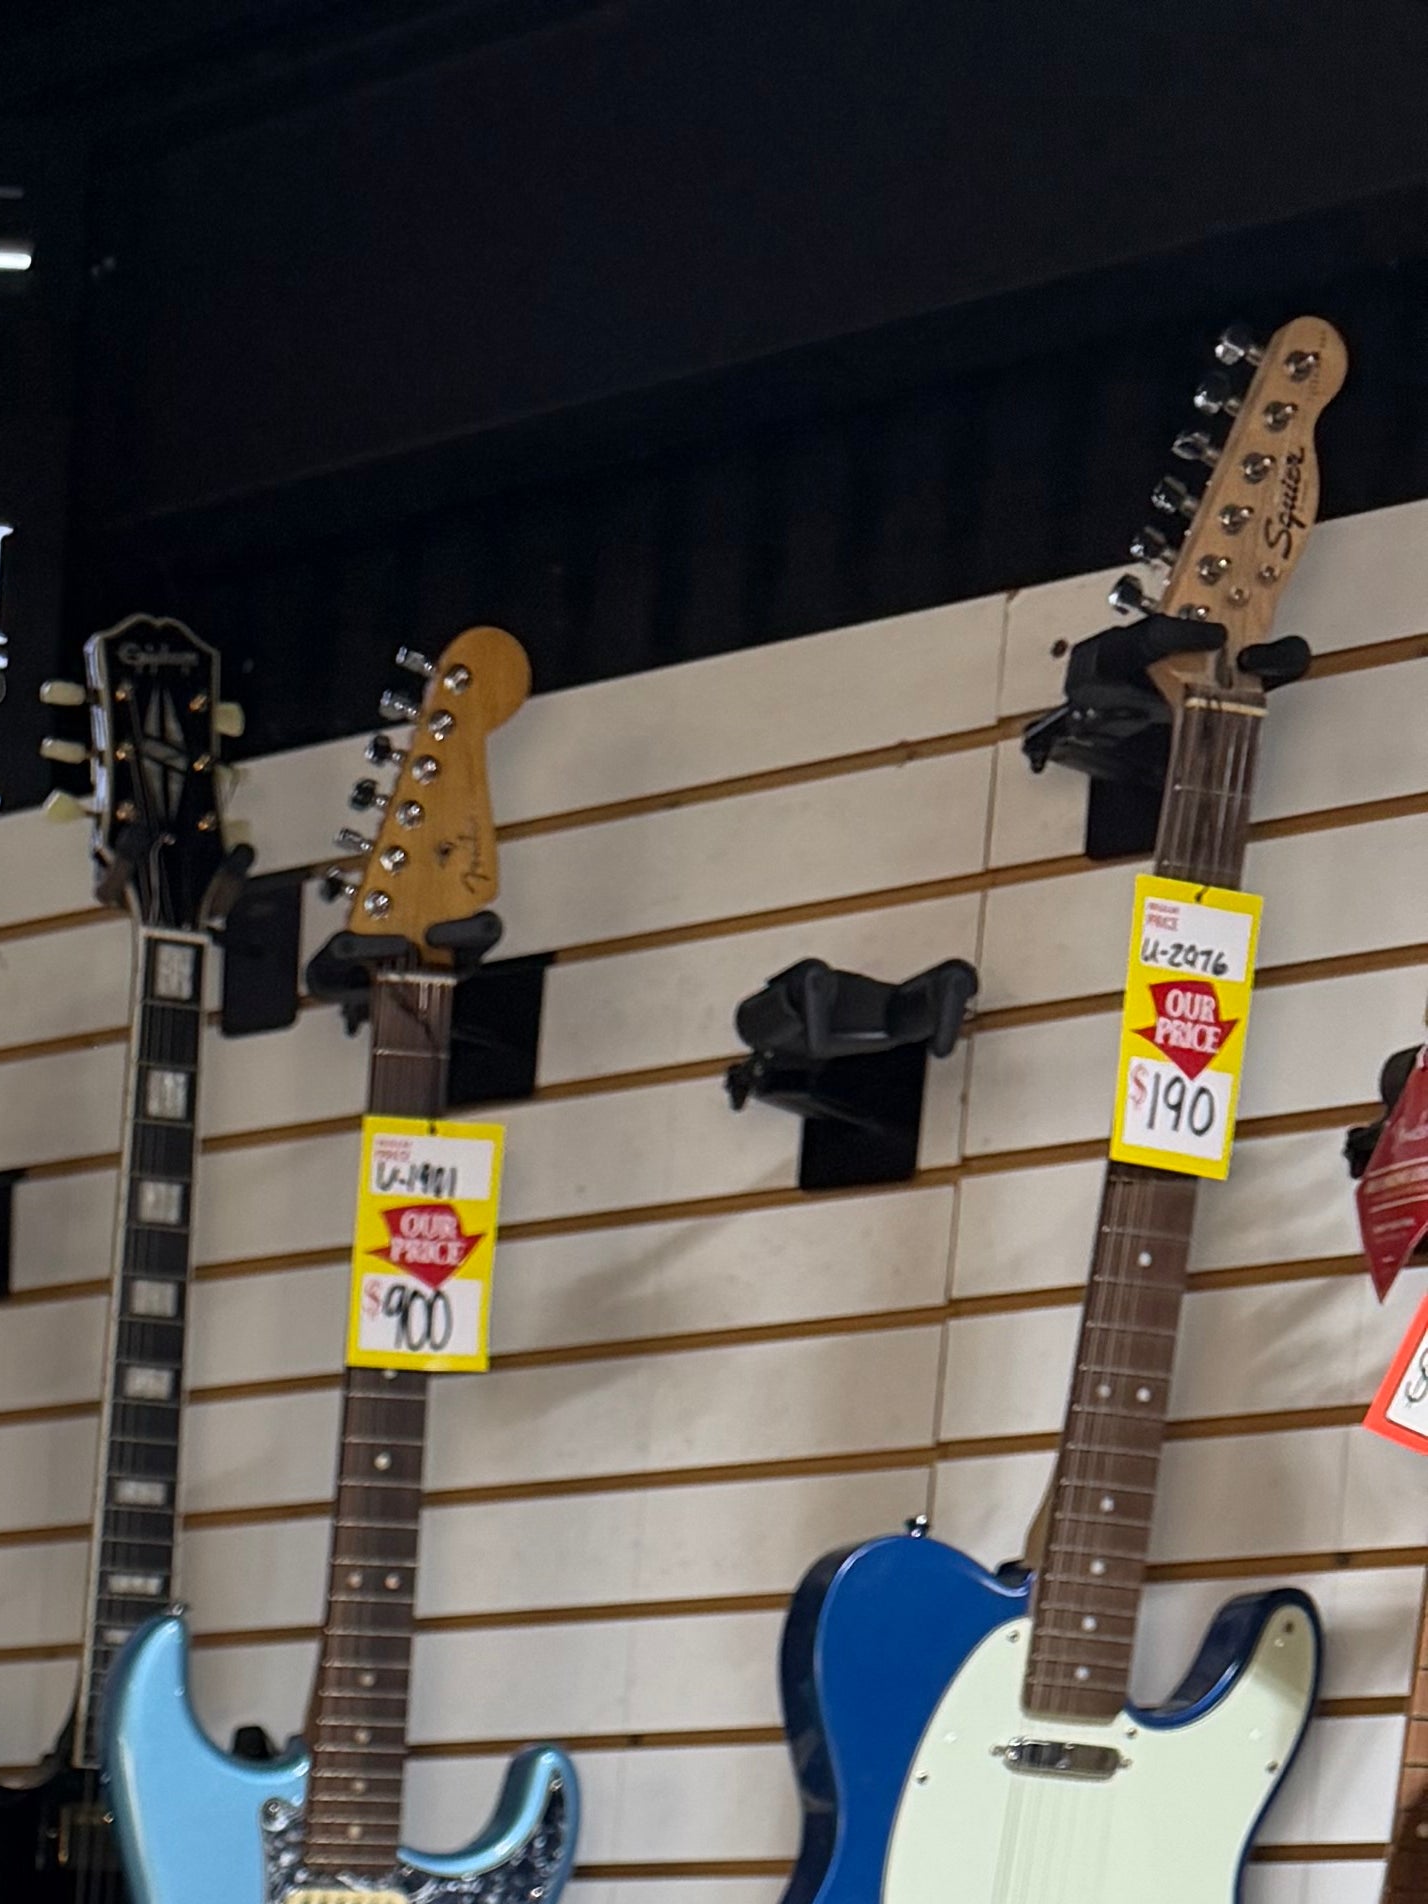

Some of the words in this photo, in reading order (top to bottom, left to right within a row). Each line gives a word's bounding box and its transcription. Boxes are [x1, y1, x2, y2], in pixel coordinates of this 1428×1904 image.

[1164, 988, 1217, 1024] OUR
[1153, 1015, 1222, 1055] PRICE
[399, 1209, 459, 1241] OUR
[389, 1237, 470, 1266] PRICE
